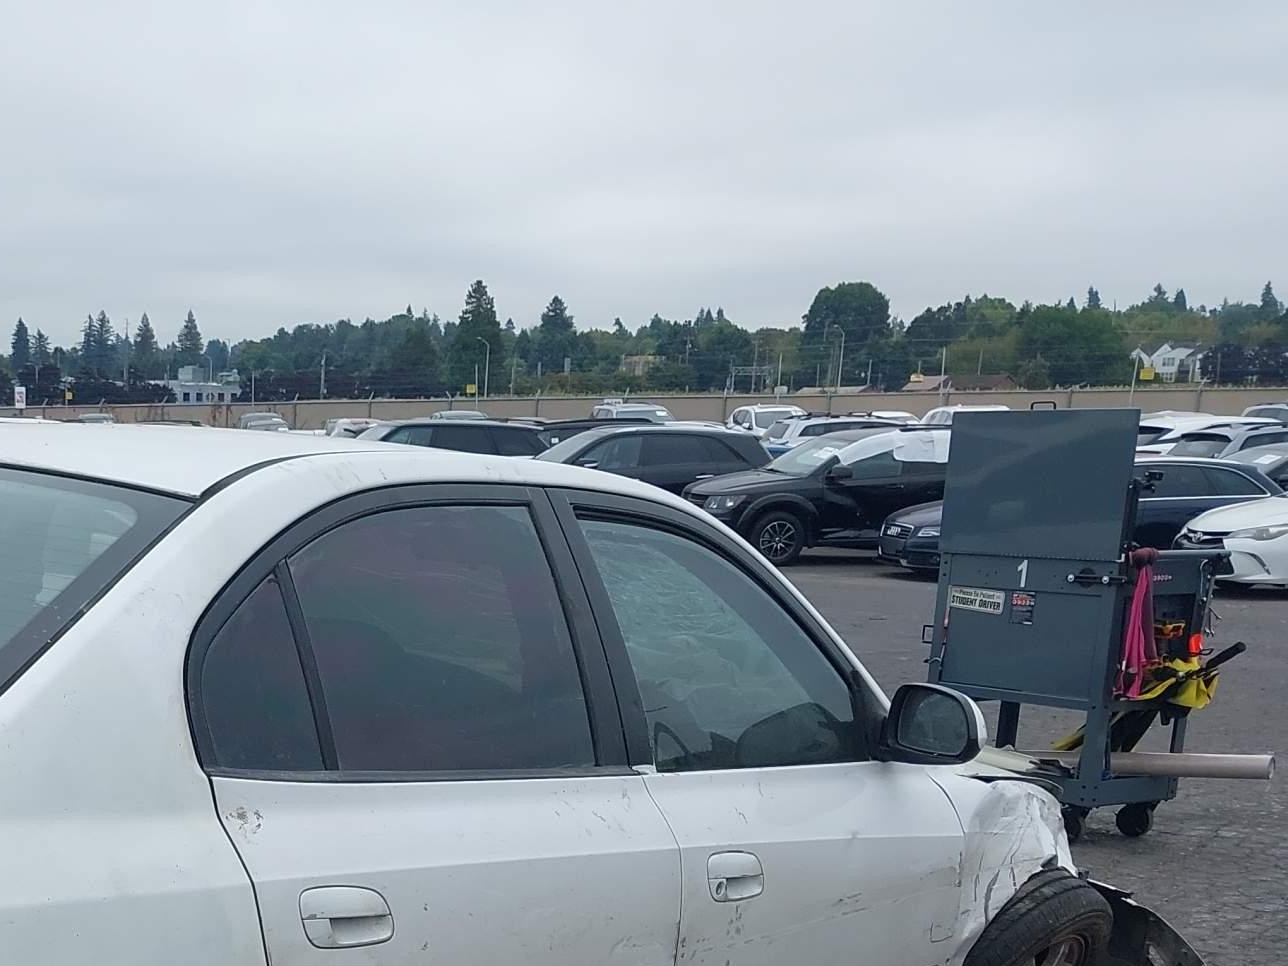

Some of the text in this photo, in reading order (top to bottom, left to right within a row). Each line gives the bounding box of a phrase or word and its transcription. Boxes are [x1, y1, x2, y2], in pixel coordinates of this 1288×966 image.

[1017, 559, 1029, 588] 1
[951, 594, 978, 607] STUDENT
[978, 599, 1001, 611] DRIVER
